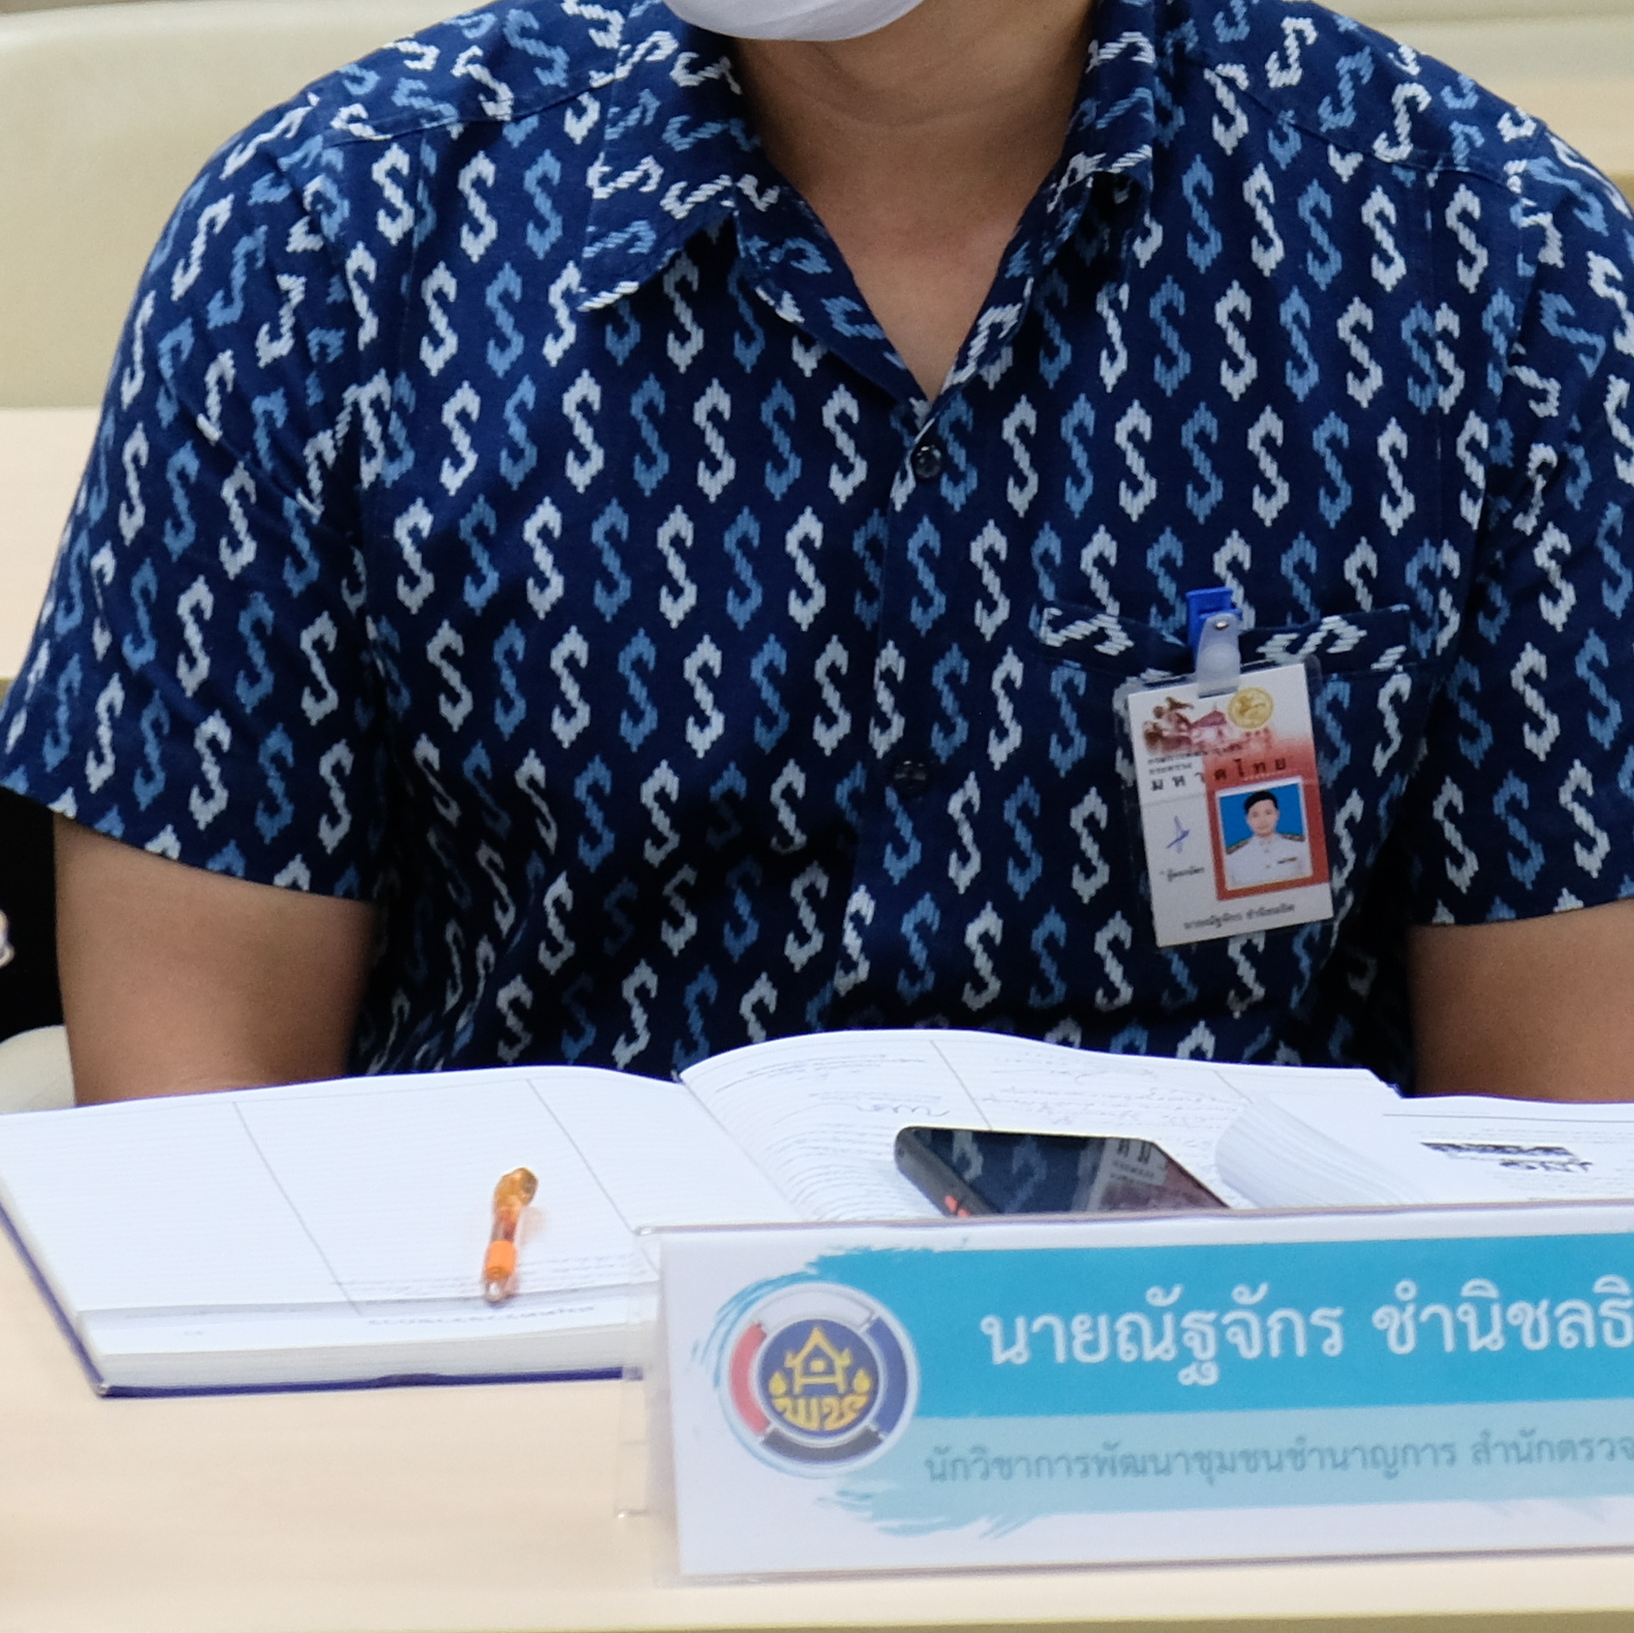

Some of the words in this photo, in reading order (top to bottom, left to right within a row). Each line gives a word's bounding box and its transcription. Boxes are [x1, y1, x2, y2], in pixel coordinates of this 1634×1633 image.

[979, 1281, 1345, 1386] นายณัฐจักร
[924, 1435, 1458, 1486] นักวิชาการพัฒนาชุมชนชำนาญการ
